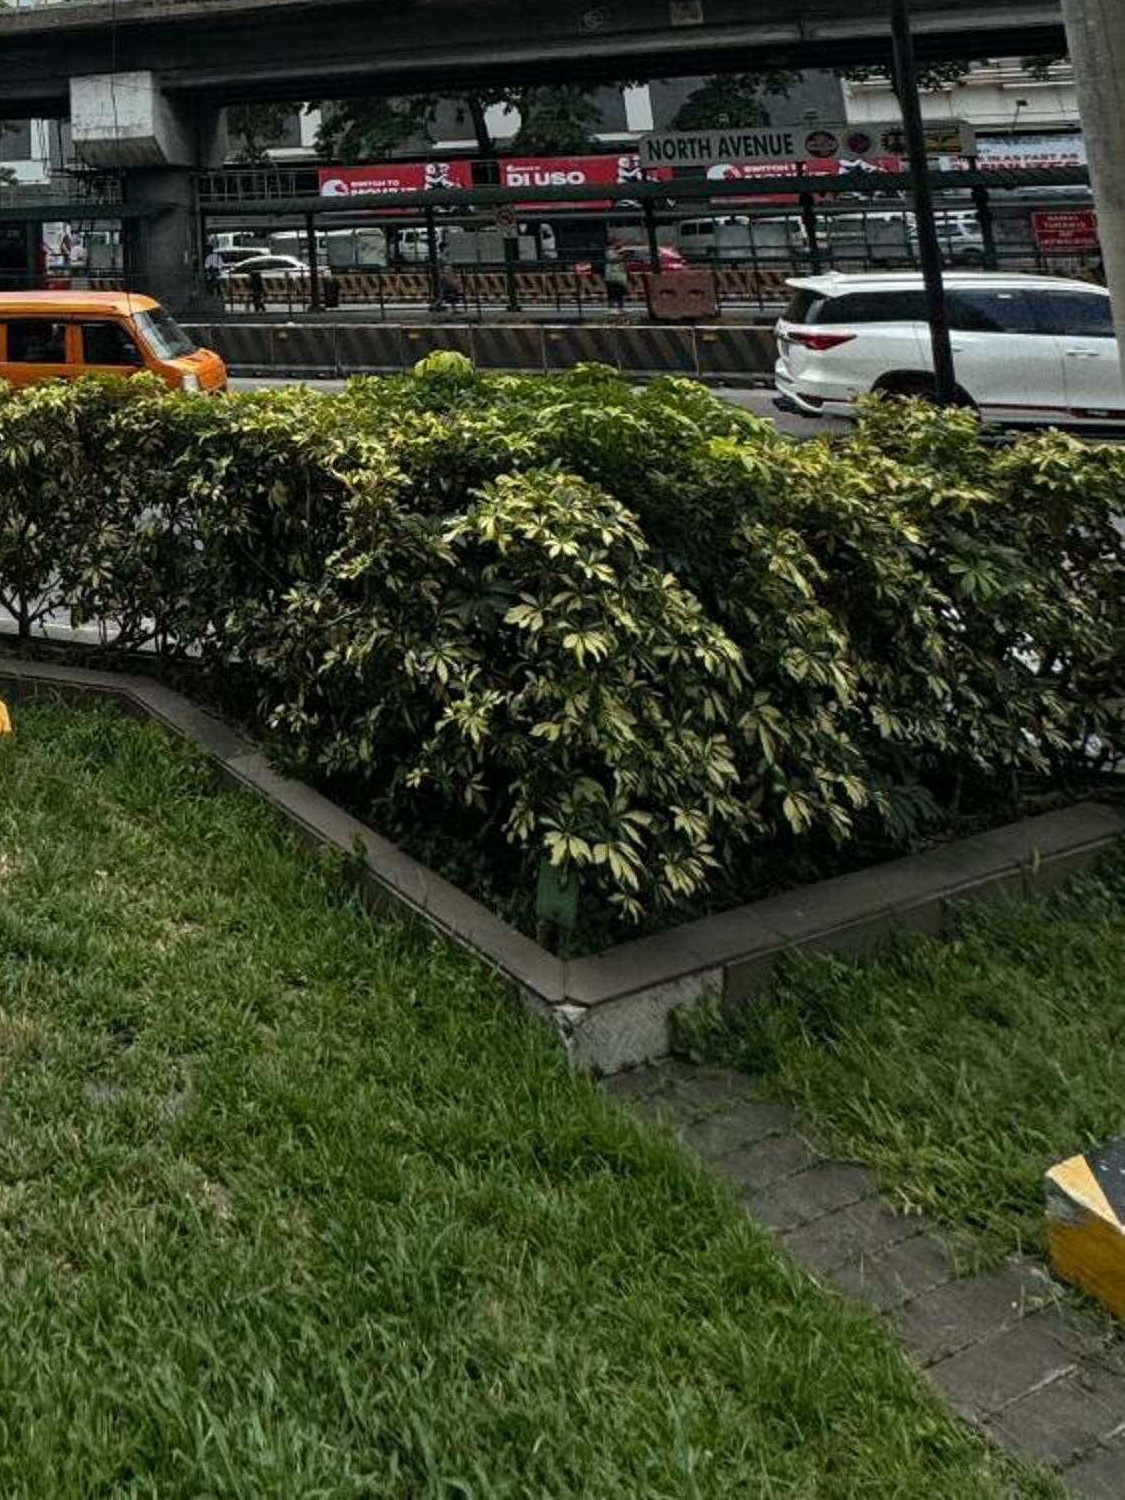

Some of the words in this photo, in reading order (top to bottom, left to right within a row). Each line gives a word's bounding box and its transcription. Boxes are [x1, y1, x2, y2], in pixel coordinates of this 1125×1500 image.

[647, 138, 712, 160] NORTH
[718, 133, 794, 157] AVENUE
[506, 173, 530, 187] DI
[534, 171, 586, 186] USO
